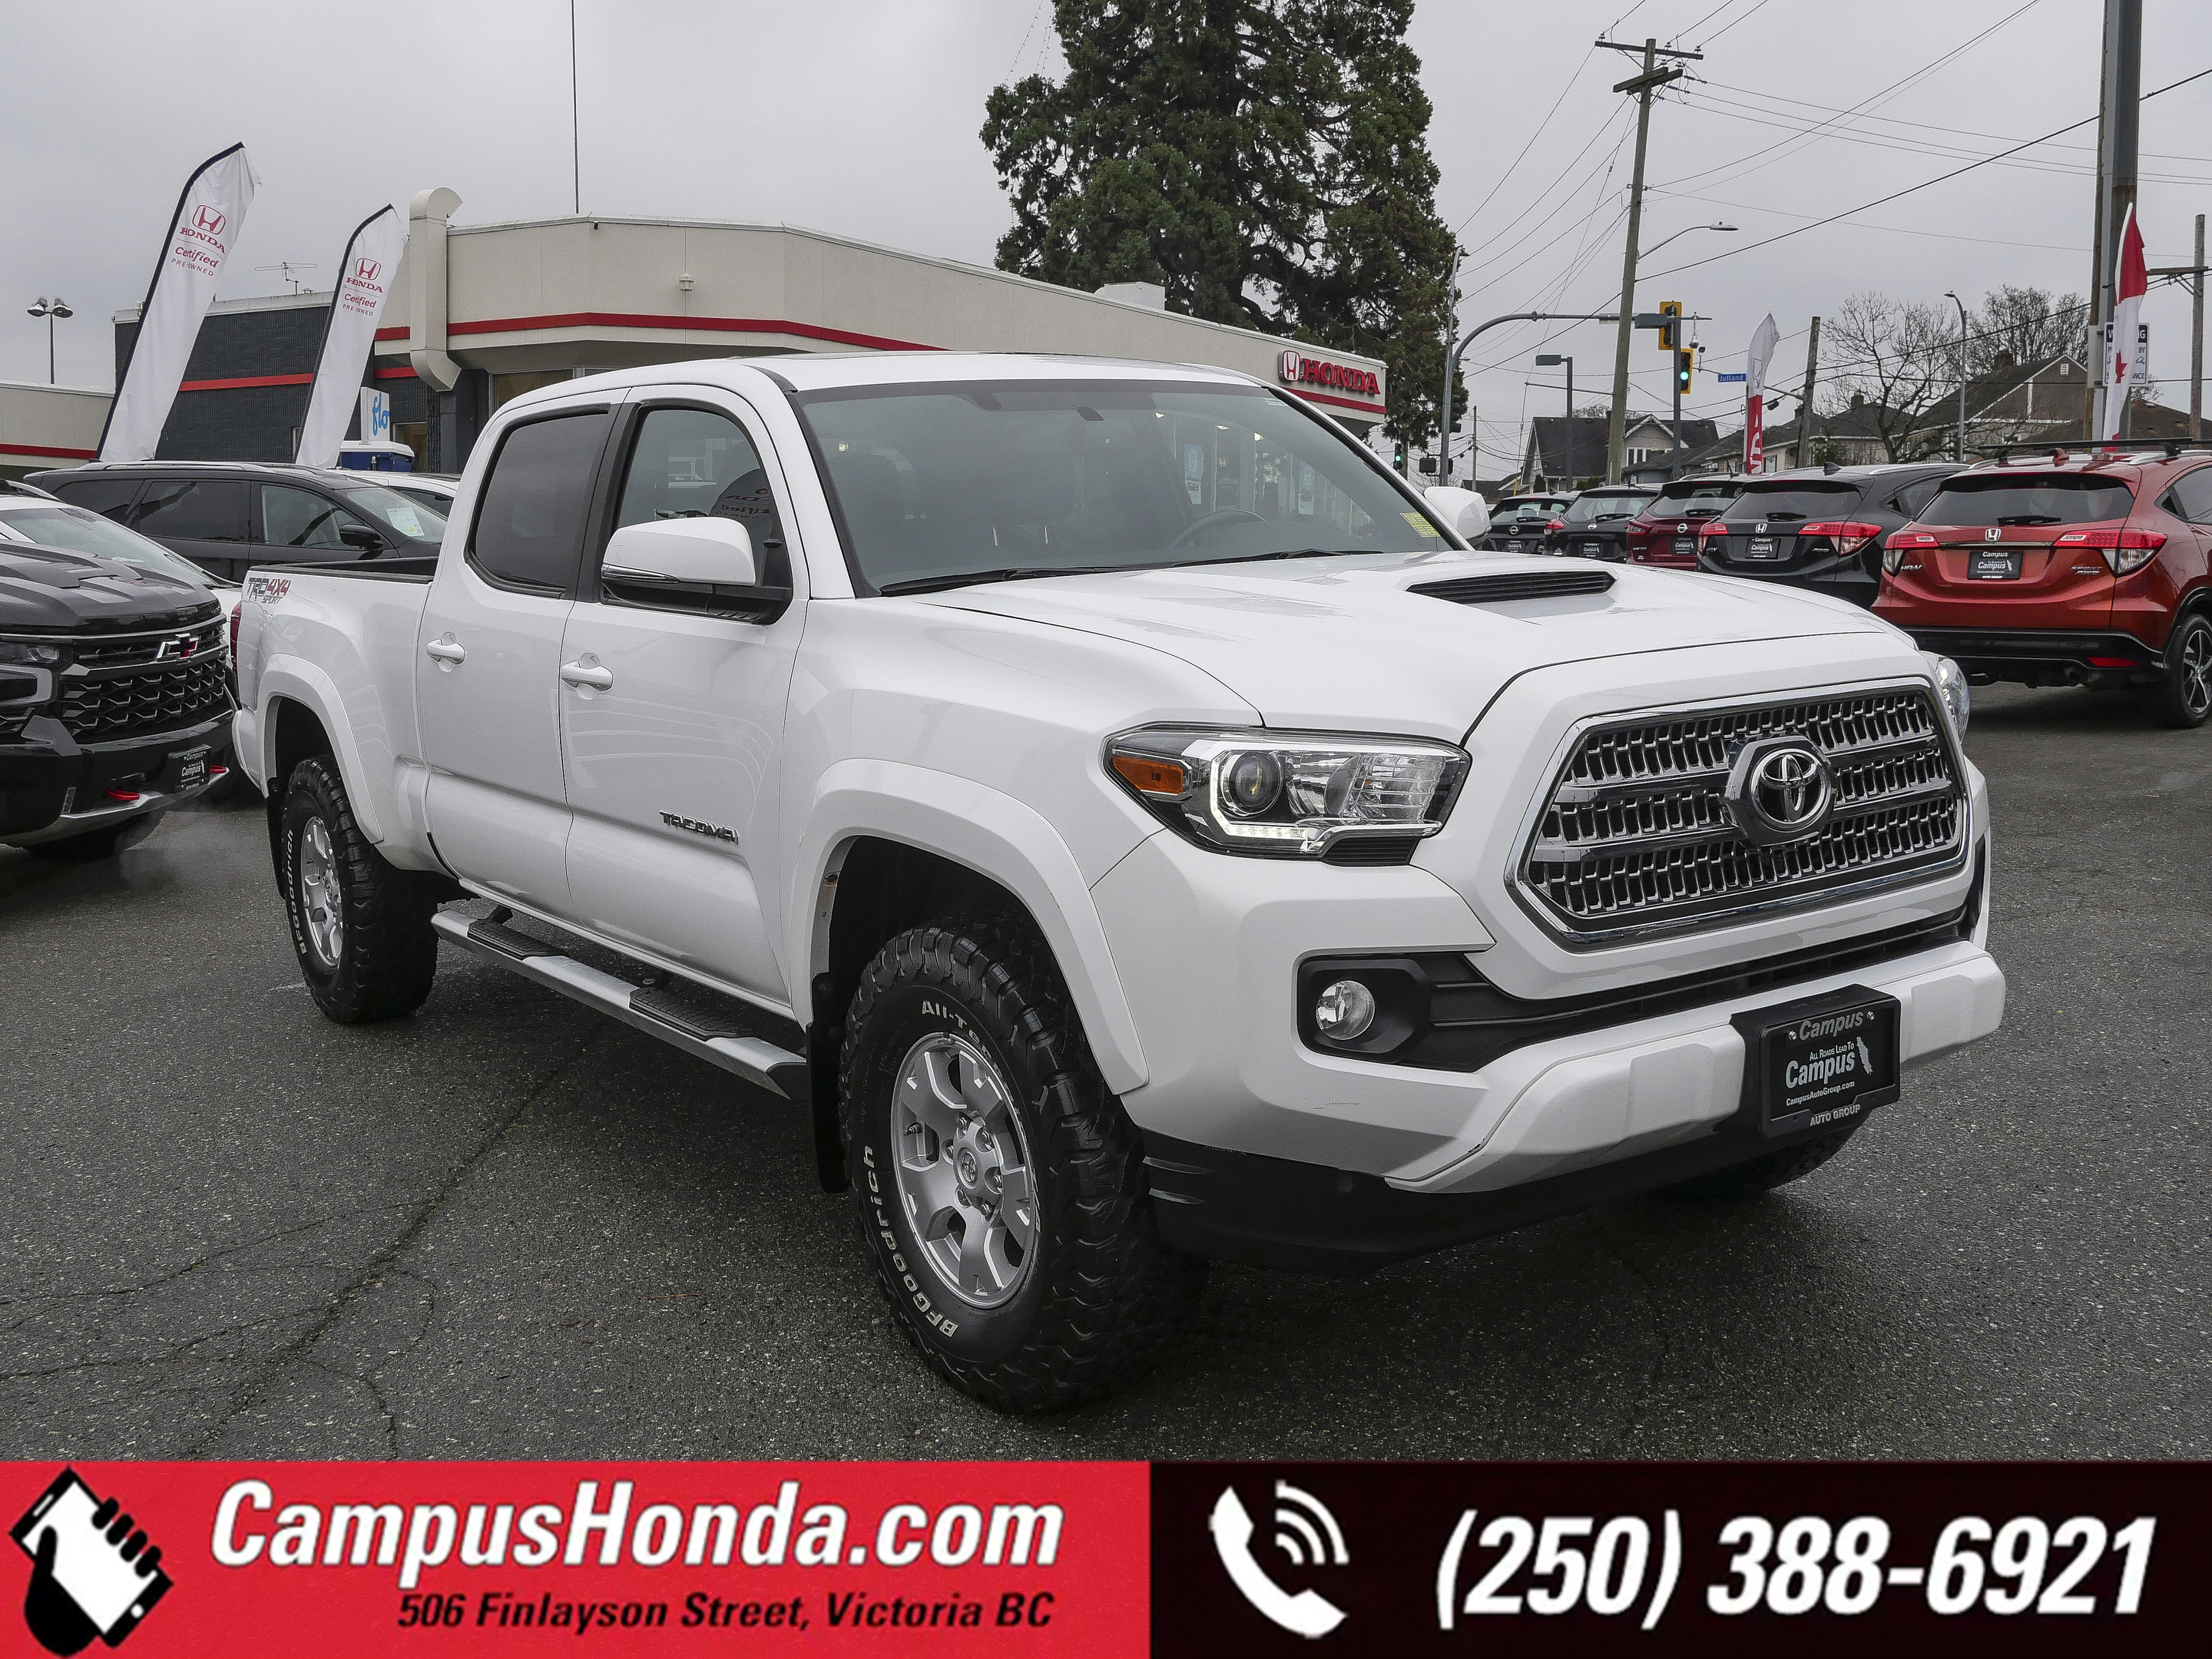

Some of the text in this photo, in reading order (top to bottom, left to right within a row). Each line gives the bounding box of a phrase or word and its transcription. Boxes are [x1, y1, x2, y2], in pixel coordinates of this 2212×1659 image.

[180, 227, 225, 255] HONDA
[171, 258, 214, 276] PRE-OWNED
[175, 247, 219, 268] Certified
[1302, 358, 1380, 395] HONDA
[1978, 561, 2006, 571] Campus
[659, 809, 739, 846] TACOMA
[1800, 1012, 1864, 1041] Campus
[1786, 1051, 1856, 1089] Campus
[1786, 1081, 1855, 1106] CampusAutoGroup.com
[1810, 1104, 1861, 1127] AUTO GROUP
